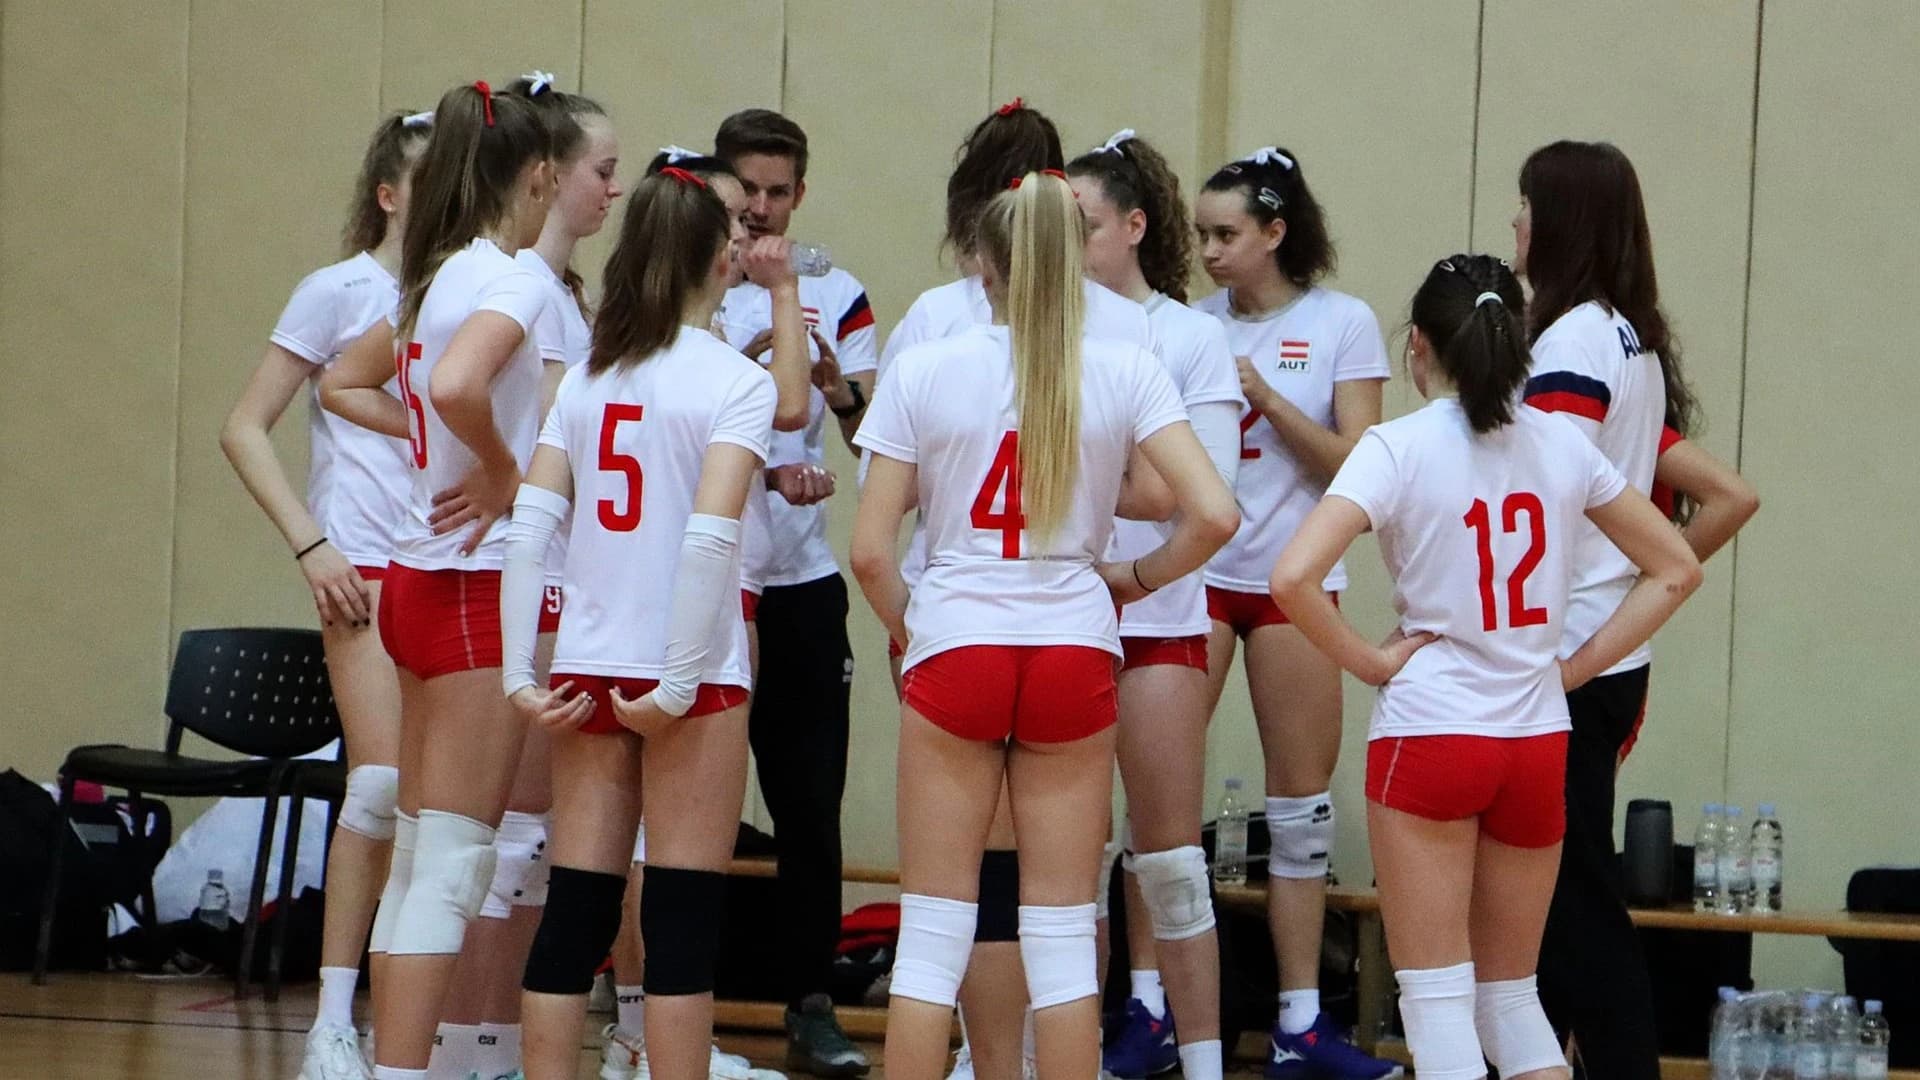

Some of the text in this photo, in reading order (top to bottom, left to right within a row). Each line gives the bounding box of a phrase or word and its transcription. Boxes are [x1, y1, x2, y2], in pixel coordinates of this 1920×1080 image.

[1278, 360, 1308, 370] AUT
[597, 403, 644, 532] 5
[970, 430, 1028, 559] 4
[1463, 492, 1548, 632] 12
